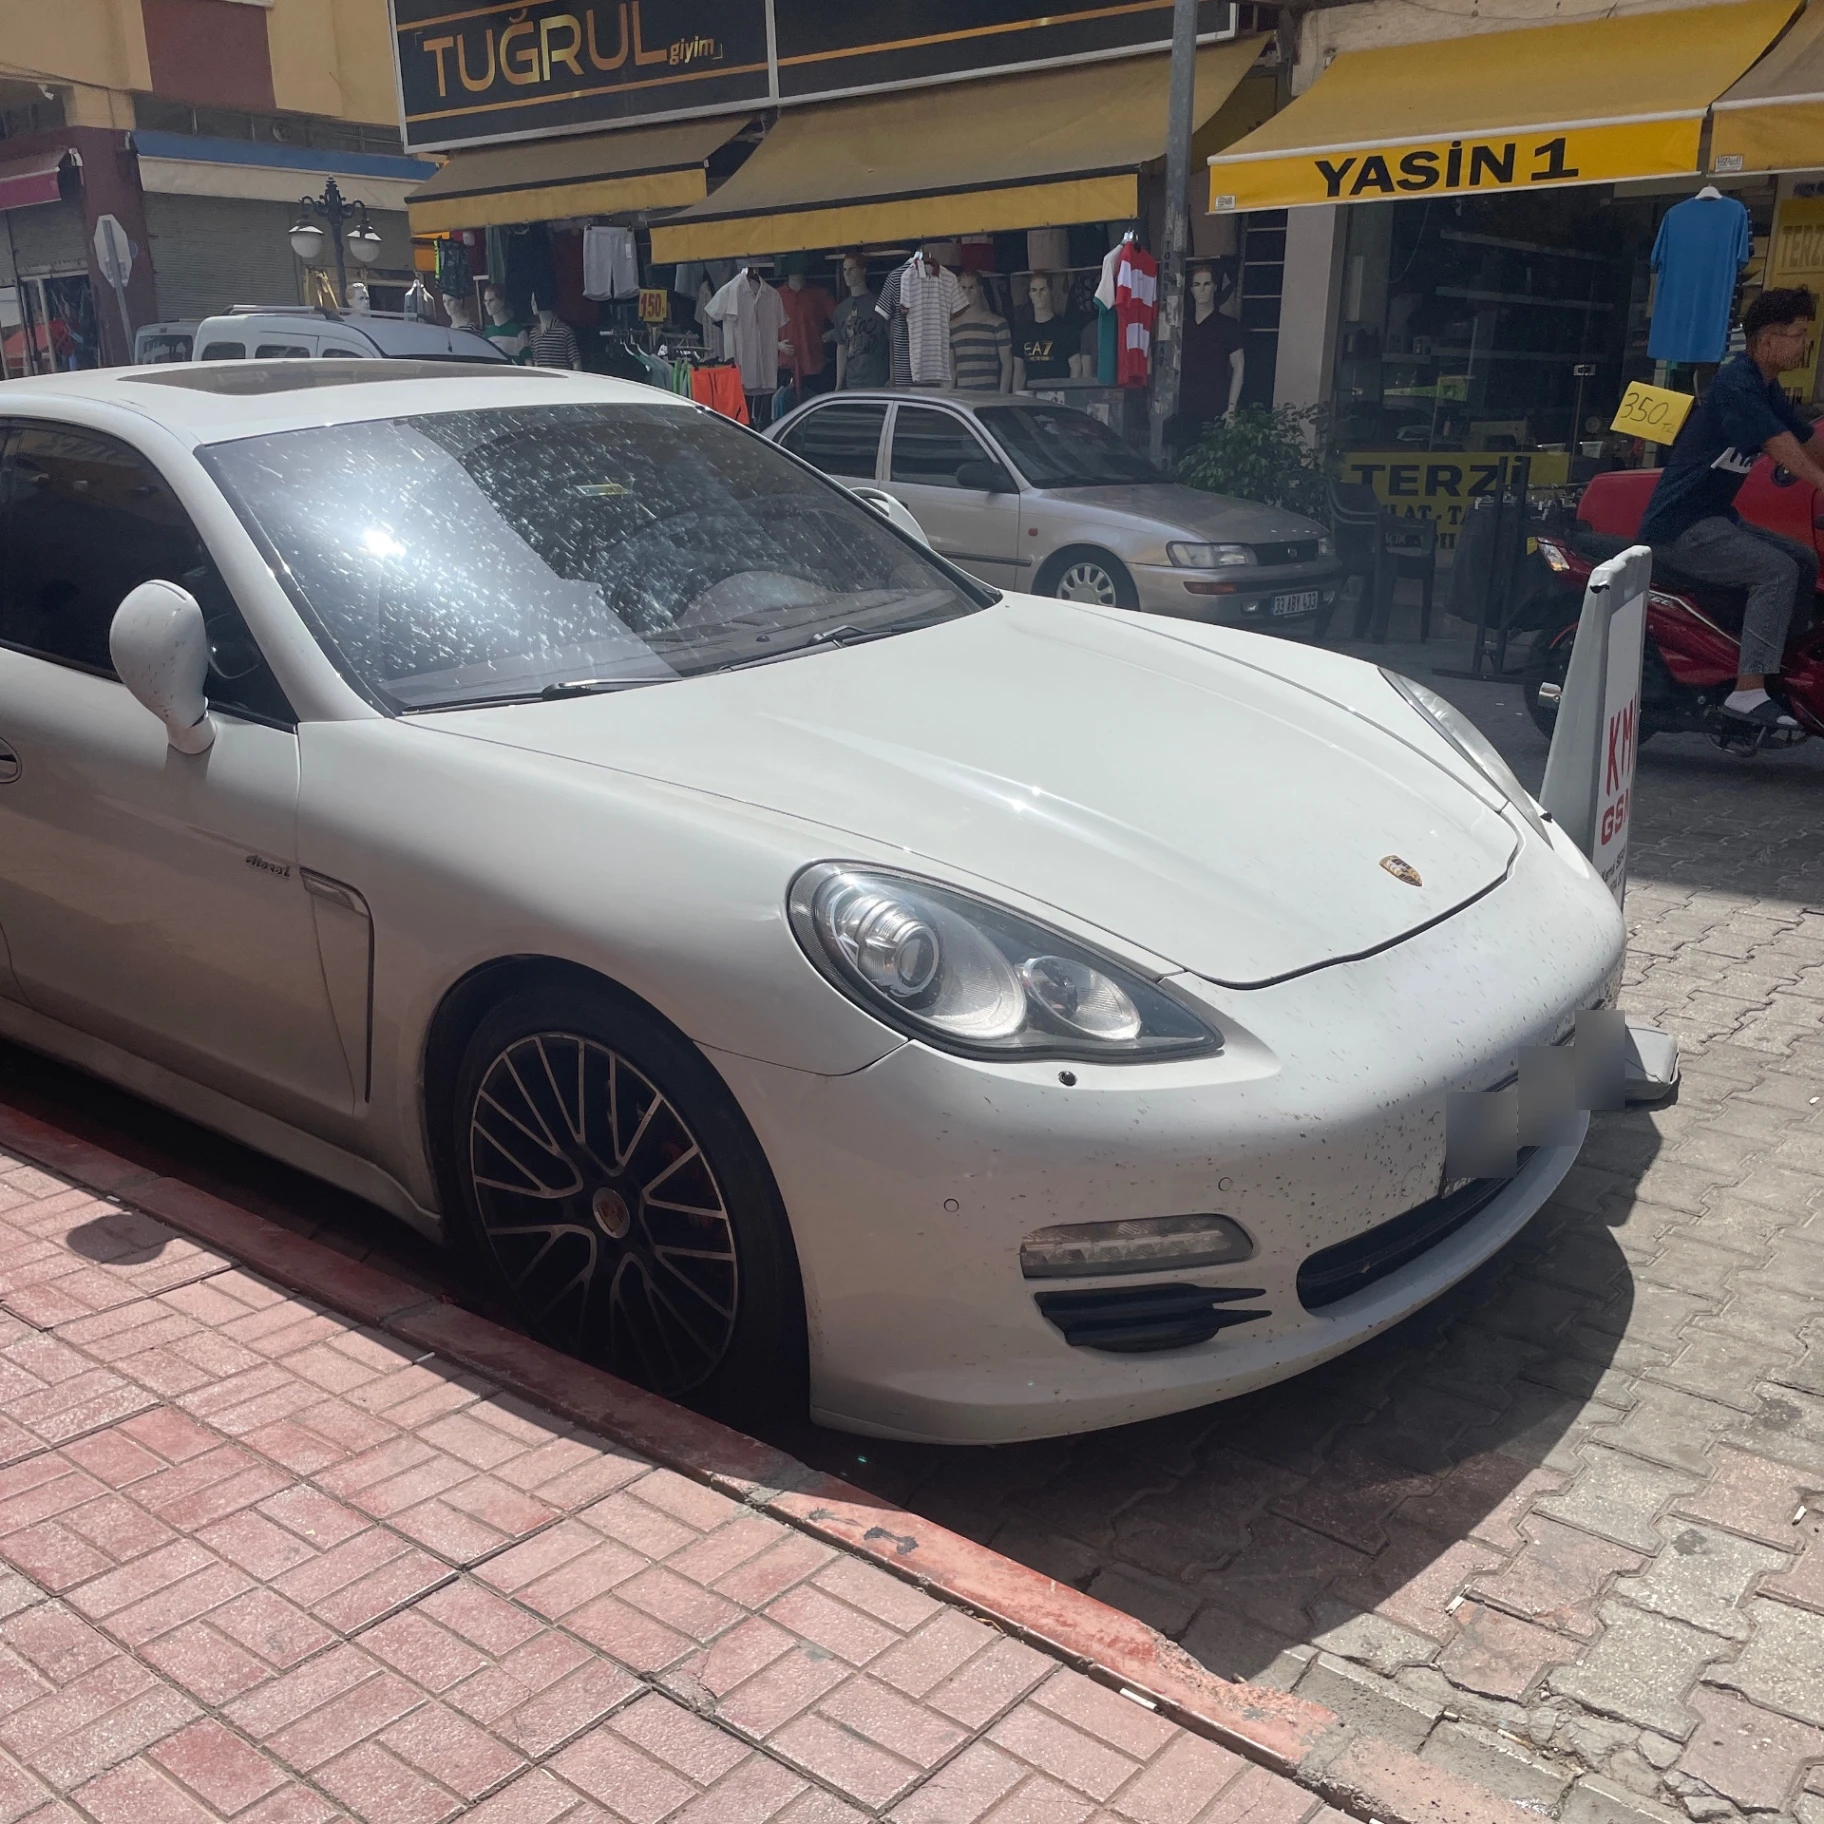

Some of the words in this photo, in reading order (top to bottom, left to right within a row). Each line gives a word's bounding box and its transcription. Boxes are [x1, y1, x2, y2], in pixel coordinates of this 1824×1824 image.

[423, 0, 667, 97] TUĞRUL
[668, 36, 714, 65] giyim
[1315, 140, 1516, 197] YASİN
[1531, 138, 1579, 181] 1
[1781, 224, 1824, 268] TERZ
[1023, 340, 1053, 356] EA7
[1620, 392, 1669, 425] 350
